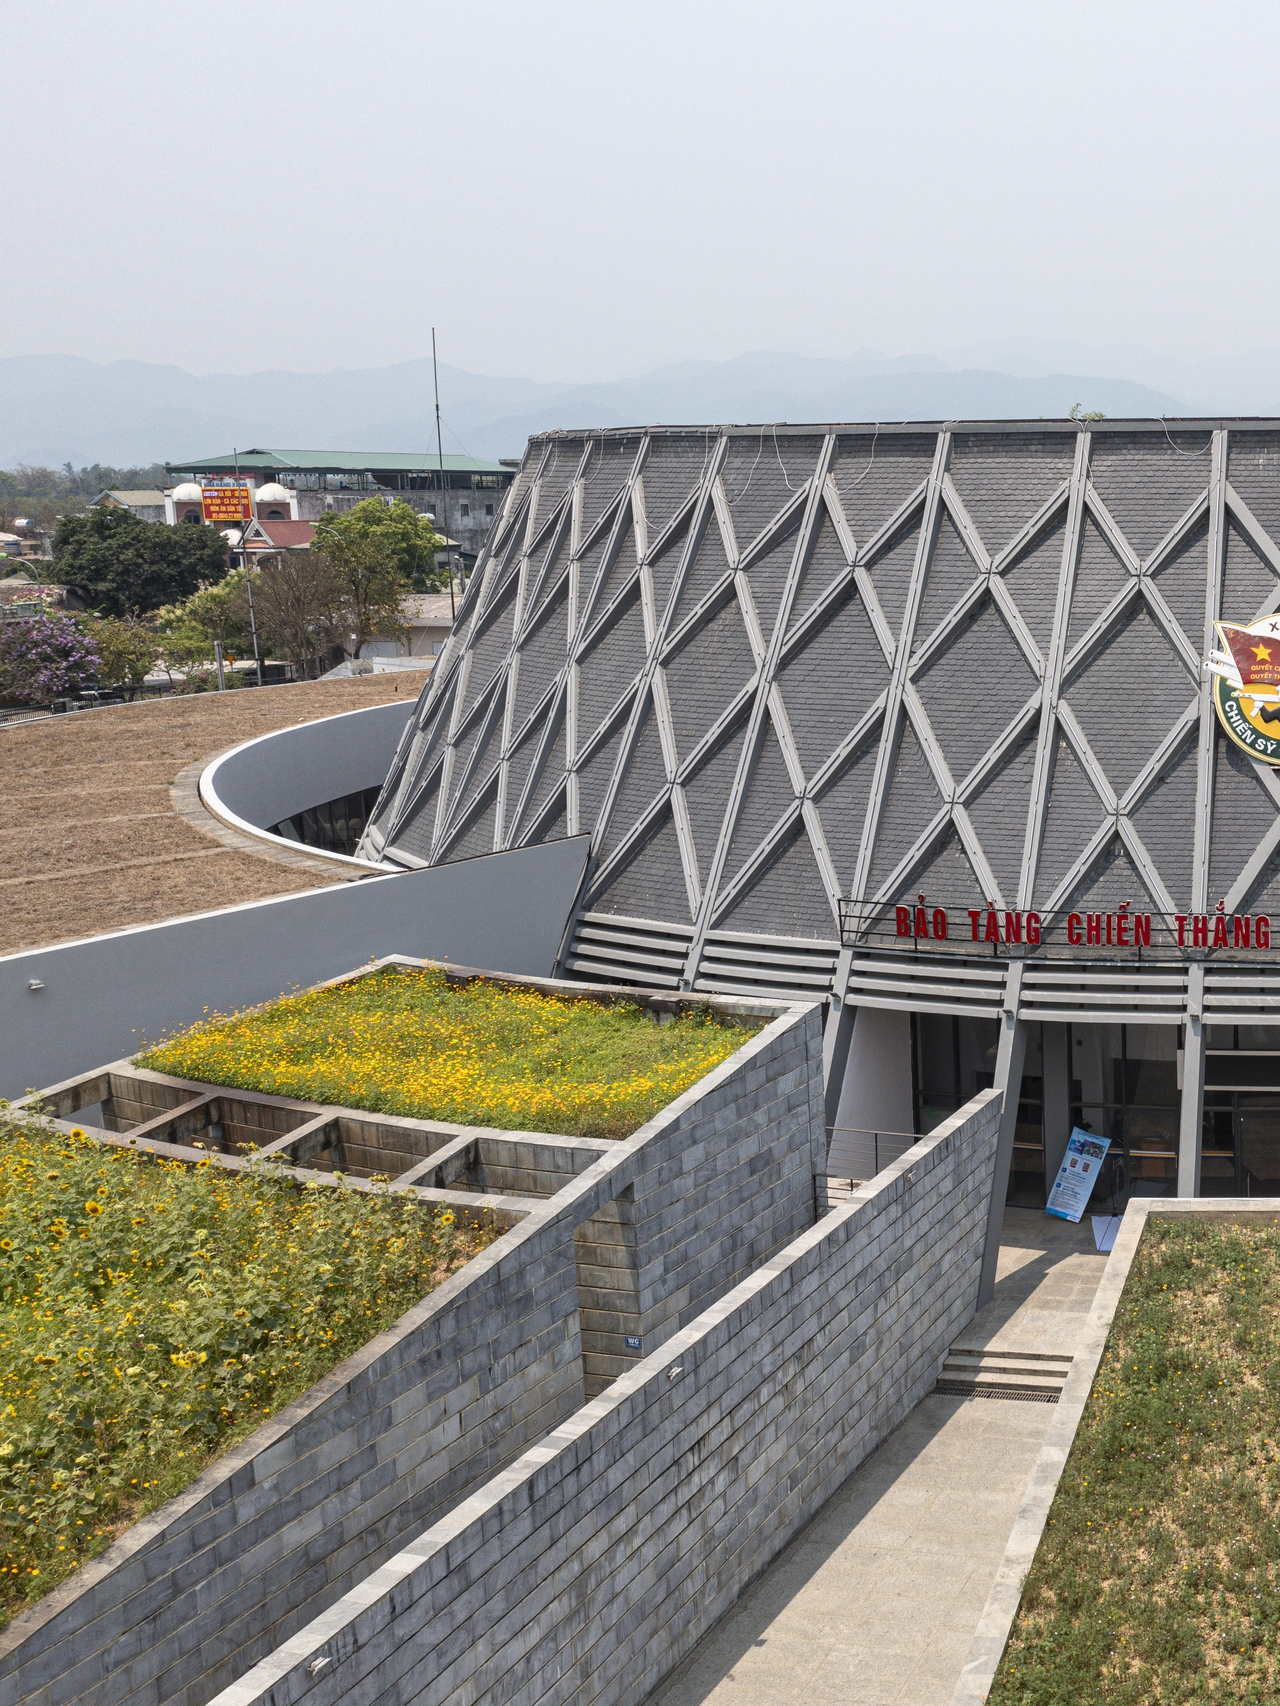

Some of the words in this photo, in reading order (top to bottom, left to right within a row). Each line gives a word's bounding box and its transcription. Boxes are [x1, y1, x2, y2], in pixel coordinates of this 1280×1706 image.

[1250, 662, 1273, 672] QUYẾT
[1250, 672, 1273, 680] QUYẾT
[1224, 700, 1256, 744] CHIẾN
[1255, 738, 1278, 755] SỸ
[895, 890, 948, 941] BẢO
[968, 900, 1042, 946] TÀNG
[1067, 900, 1152, 947] CHIẾN
[1174, 898, 1271, 950] THẮNG
